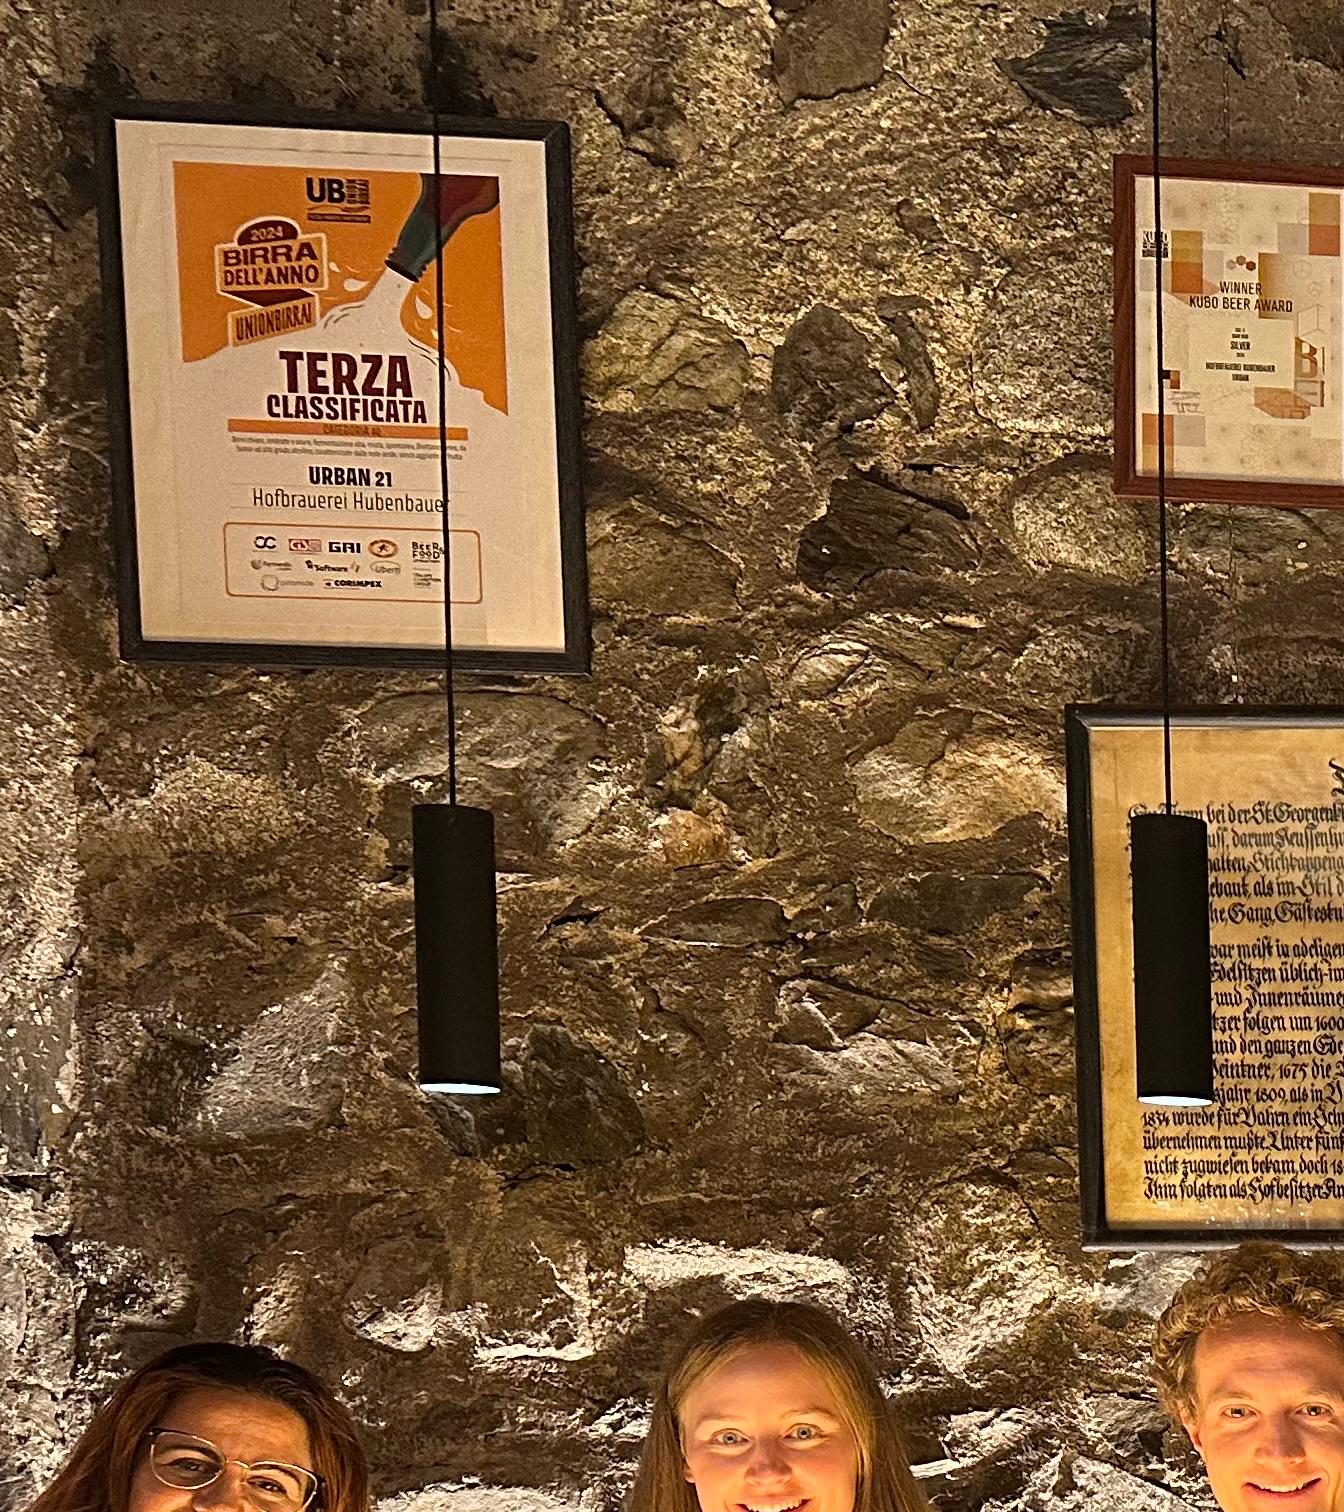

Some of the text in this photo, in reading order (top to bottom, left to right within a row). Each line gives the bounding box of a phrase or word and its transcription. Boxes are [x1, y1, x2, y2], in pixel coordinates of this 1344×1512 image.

[306, 177, 346, 204] UB
[251, 226, 283, 241] 2024
[223, 242, 318, 267] BIRRA
[224, 264, 318, 286] DELL'ANNO
[1219, 280, 1262, 296] WINNER
[1189, 295, 1293, 313] KUBO BEER AWARD
[236, 302, 312, 341] UNIONBIRRAI
[279, 351, 413, 398] TERZA
[267, 394, 427, 424] CLASSIFICATA
[309, 466, 393, 487] URBAN 21
[253, 488, 450, 514] Hofbrauerei Hubenbaue
[1206, 800, 1226, 823] bei
[1228, 800, 1249, 823] der
[1232, 826, 1276, 849] darum
[1253, 874, 1275, 899] als
[1276, 874, 1298, 898] im
[1275, 937, 1290, 959] in
[1214, 984, 1242, 1007] und
[1289, 1013, 1313, 1031] um
[1239, 1032, 1262, 1055] den
[1264, 1038, 1312, 1060] ganzen
[1279, 1061, 1308, 1080] 1675
[1311, 1057, 1331, 1079] die
[1290, 1082, 1309, 1103] als
[1310, 1082, 1323, 1103] in
[1173, 1107, 1215, 1127] wurde
[1217, 1104, 1238, 1131] für
[1238, 1105, 1290, 1131] Vahrn
[1293, 1109, 1312, 1126] ein
[1142, 1130, 1222, 1155] übernehmen
[1144, 1153, 1179, 1178] nicht
[1251, 1153, 1298, 1177] bekam,
[1299, 1153, 1328, 1177] doch
[1144, 1176, 1178, 1200] Ihm
[1180, 1176, 1231, 1204] folgten
[1230, 1177, 1248, 1199] als
